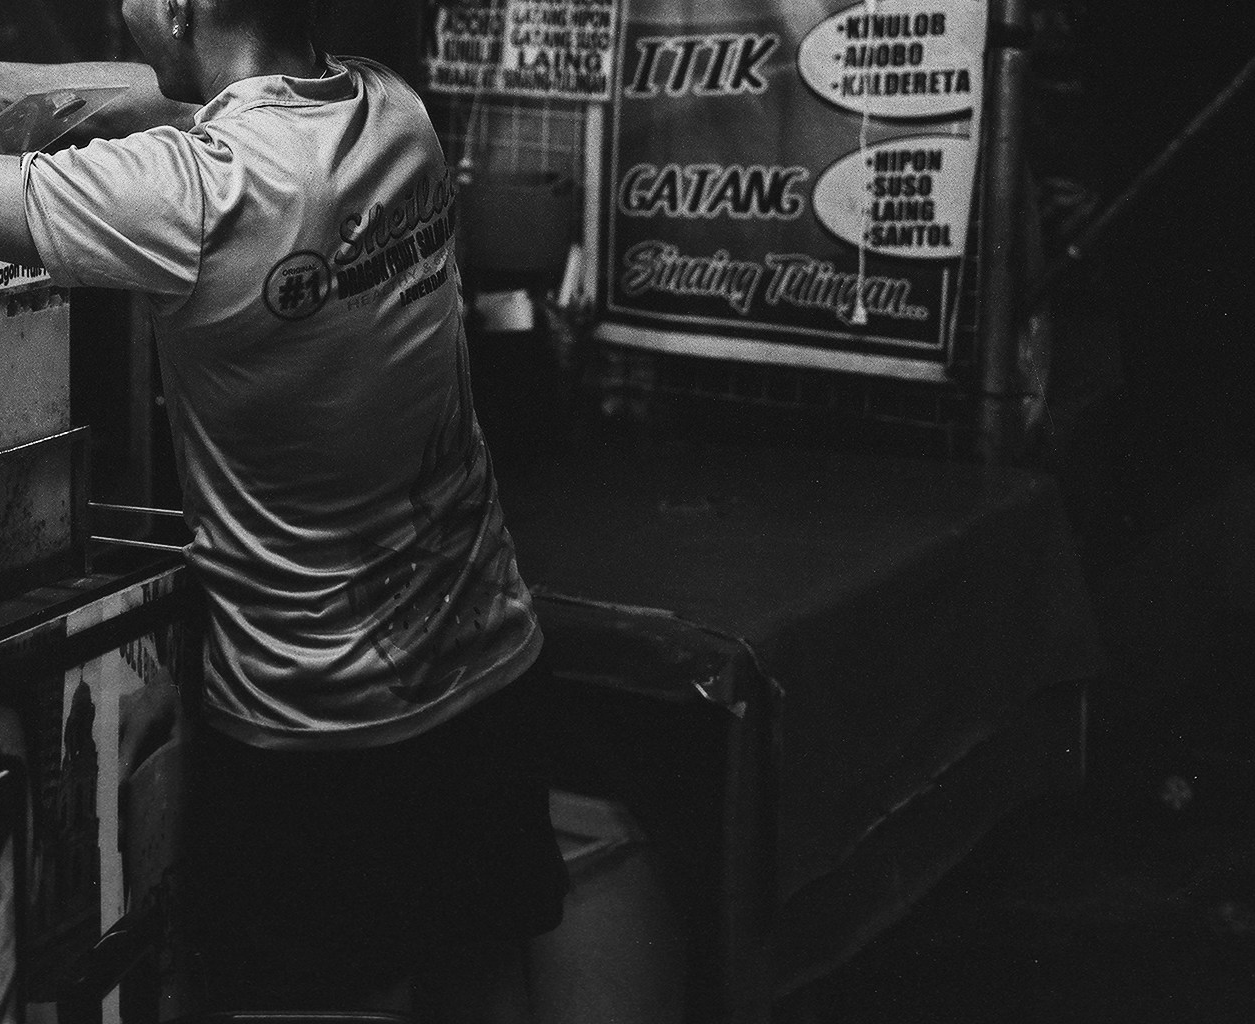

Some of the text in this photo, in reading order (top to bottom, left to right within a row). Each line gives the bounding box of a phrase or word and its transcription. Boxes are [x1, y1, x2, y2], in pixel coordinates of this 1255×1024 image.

[846, 12, 946, 40] KINULOB
[624, 32, 781, 99] ITIK
[874, 149, 943, 174] HIPON
[620, 163, 810, 220] GATANG
[873, 175, 933, 197] SUSO
[871, 199, 936, 223] LAING
[870, 224, 953, 249] SANTOL
[279, 271, 320, 311] #1
